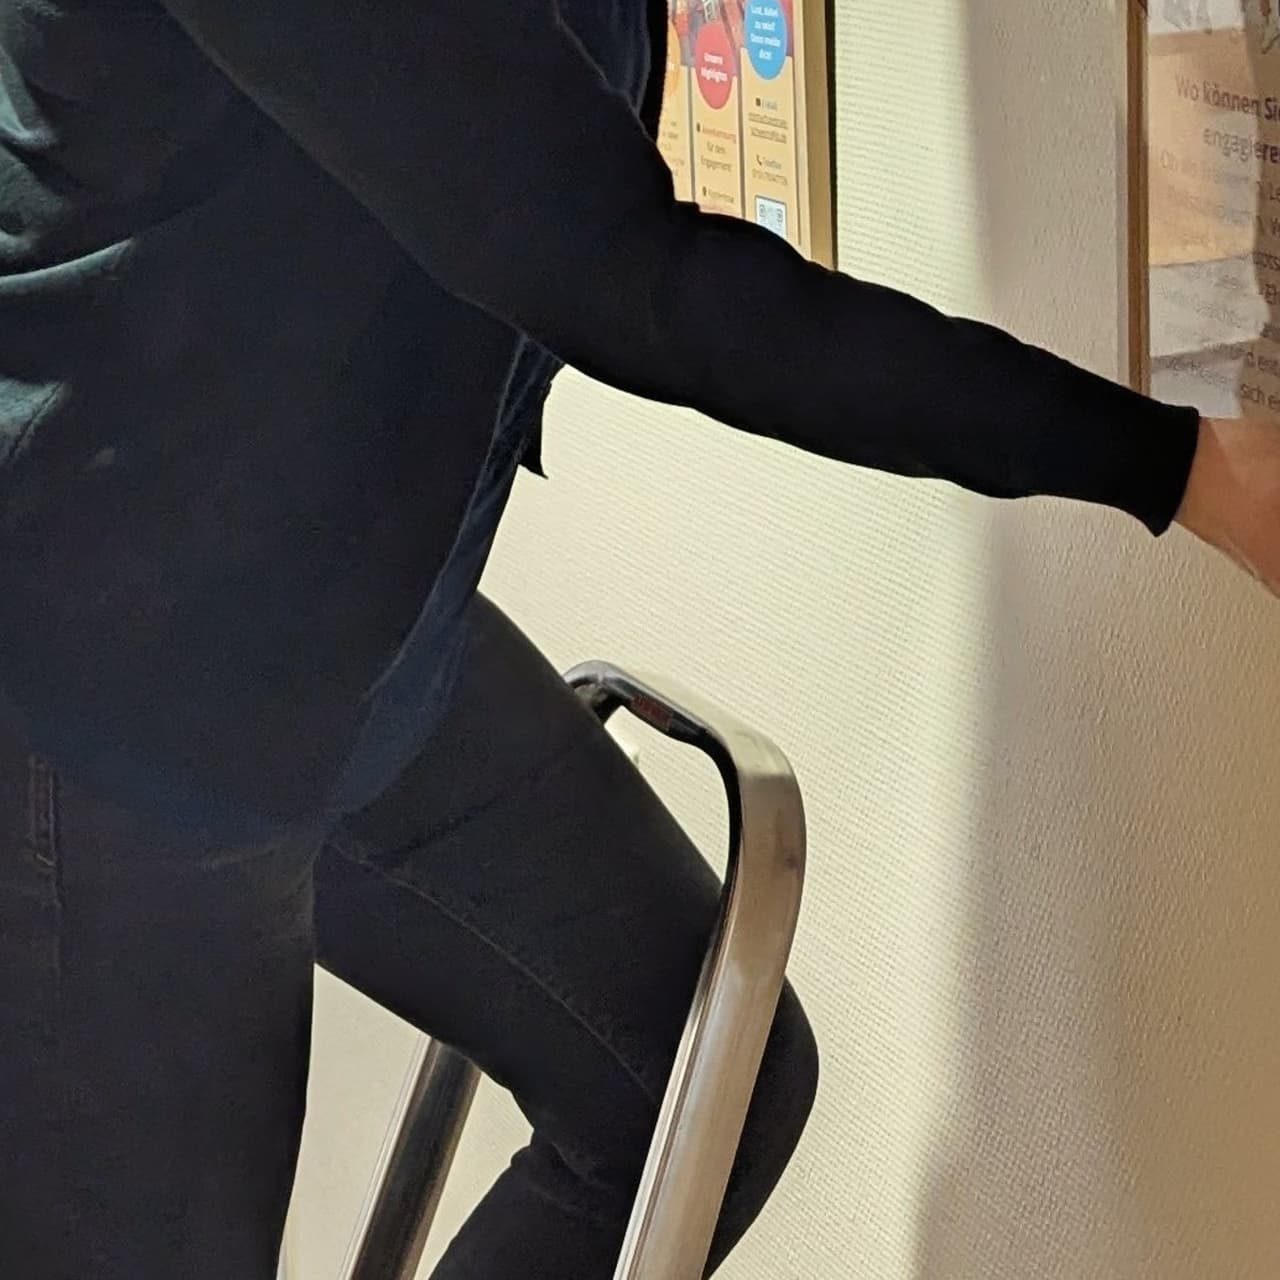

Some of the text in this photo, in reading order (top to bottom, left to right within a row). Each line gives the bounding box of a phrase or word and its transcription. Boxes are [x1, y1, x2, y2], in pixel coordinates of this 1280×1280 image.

[1175, 74, 1199, 102] Wo
[1202, 79, 1261, 117] können
[1240, 382, 1266, 406] sich
